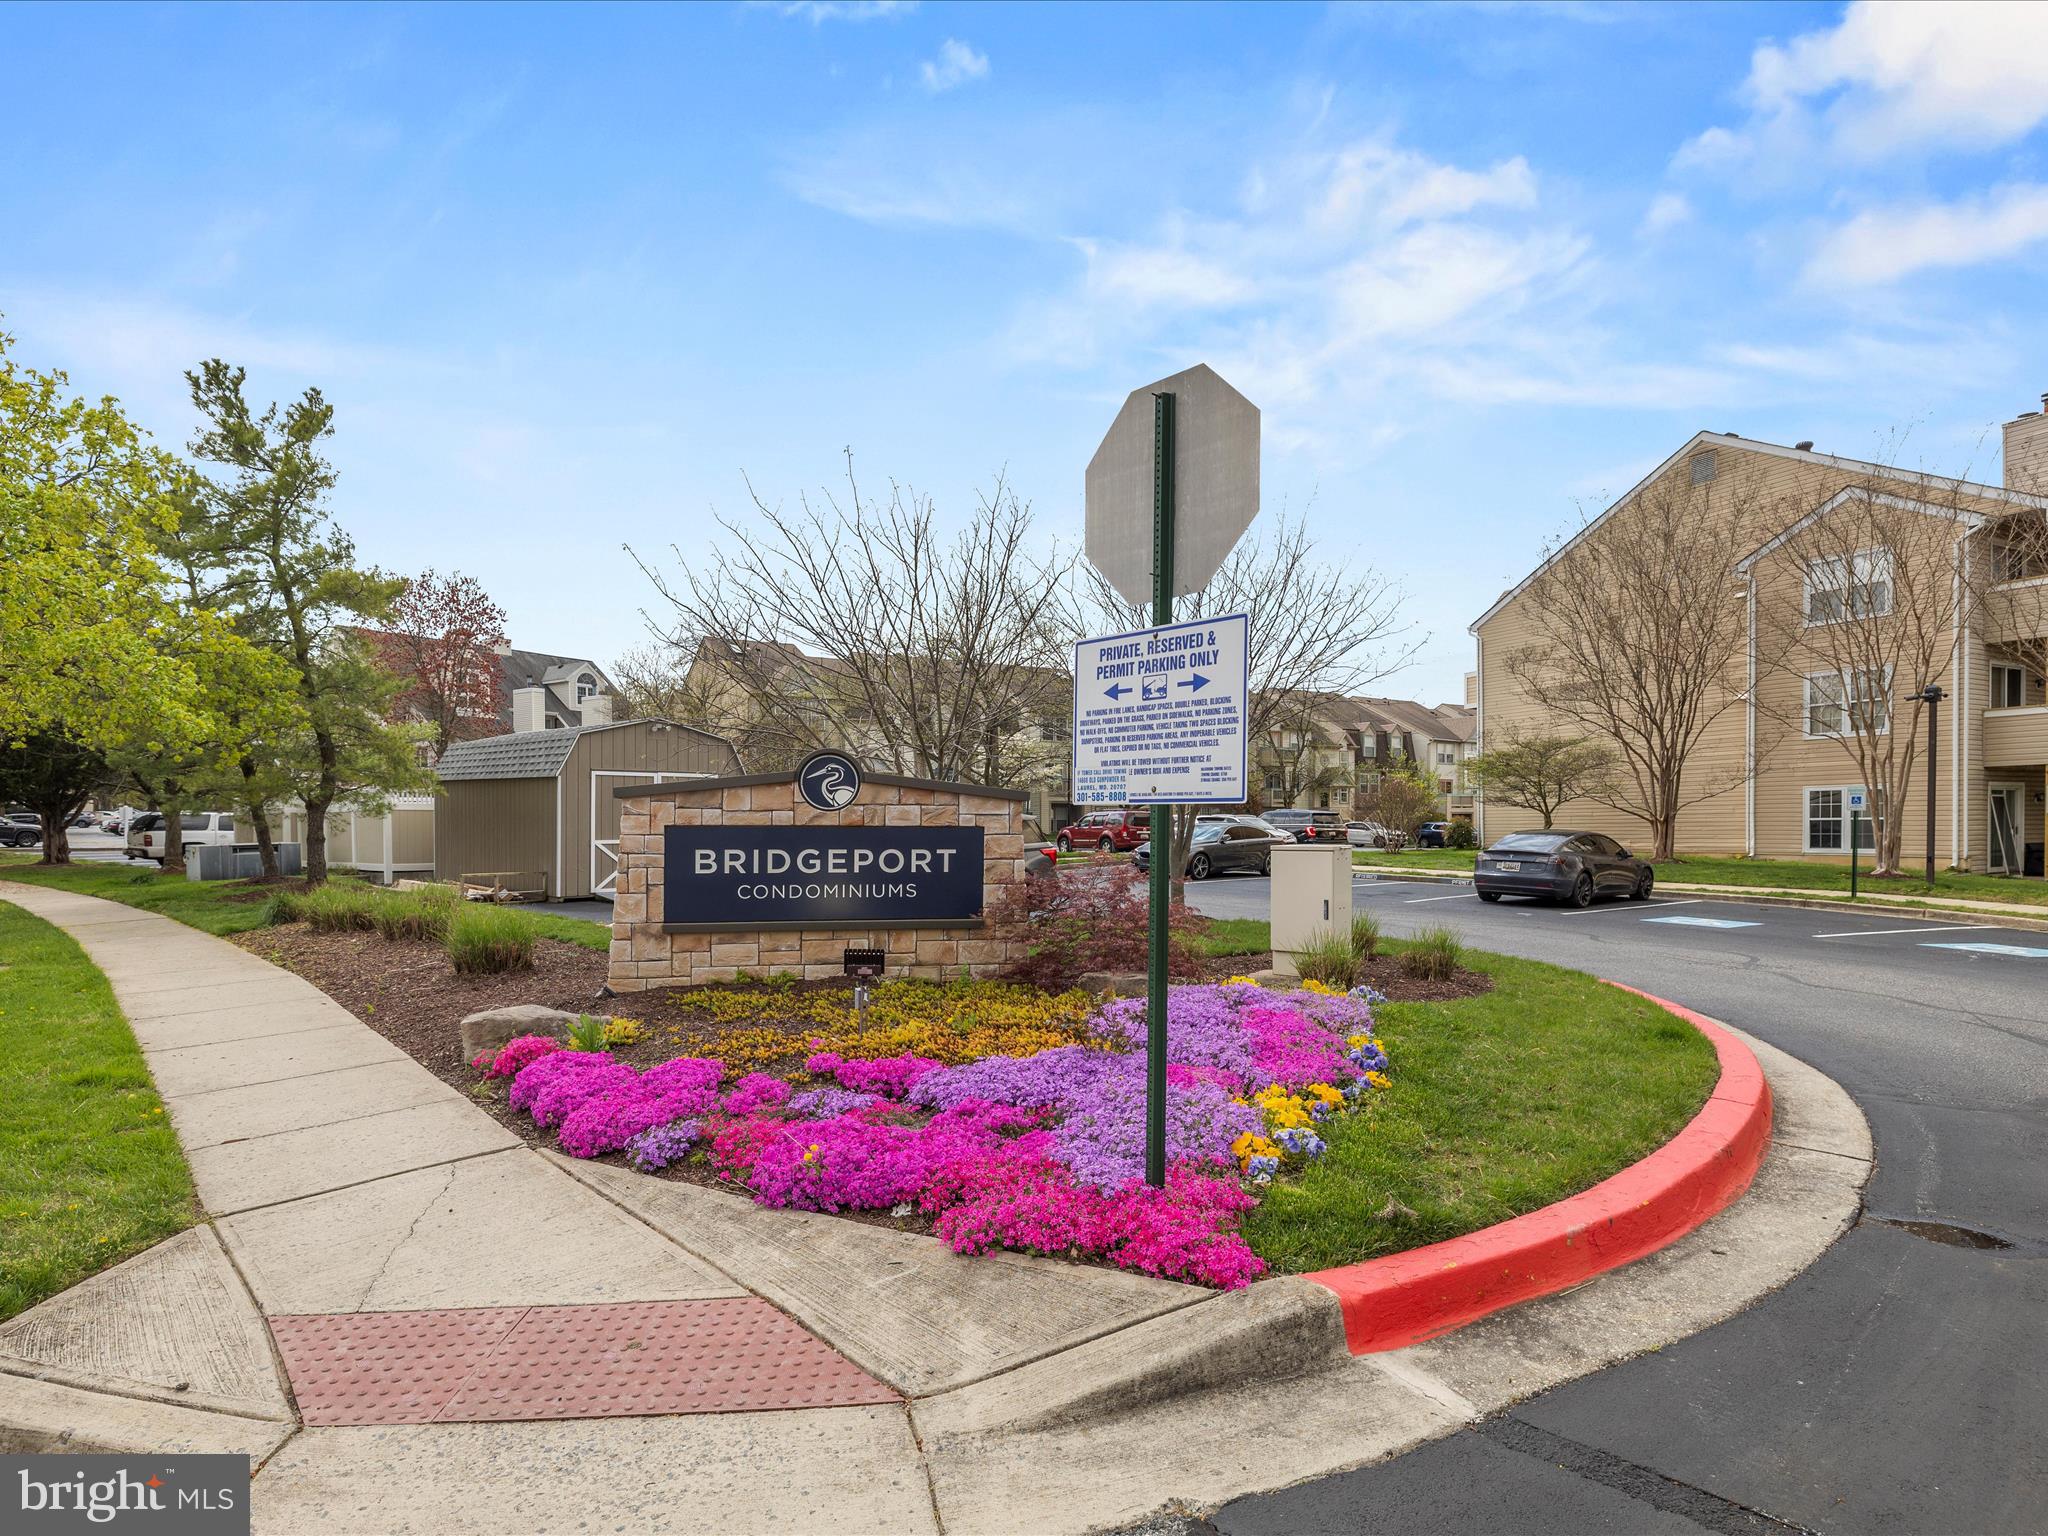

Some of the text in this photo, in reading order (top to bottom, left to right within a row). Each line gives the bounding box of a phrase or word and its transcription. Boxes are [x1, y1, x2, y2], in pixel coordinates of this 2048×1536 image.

[1100, 630, 1216, 662] PRIVATE, RESERVED &
[1097, 650, 1219, 680] PERMIT PARKING ONLY
[1092, 708, 1108, 716] PARKING
[1137, 704, 1156, 712] HANDICAP
[1210, 696, 1231, 705] BLOCKING
[1202, 708, 1221, 716] PARKING
[1115, 725, 1136, 733] COMMUTER
[1200, 718, 1216, 726] SPACES
[1217, 716, 1239, 725] BLOCKING
[1127, 734, 1145, 742] RESERVED
[1190, 729, 1215, 737] INOPERABLE
[1216, 727, 1237, 736] VEHICLES
[1170, 741, 1198, 749] COMMERCIAL
[1171, 756, 1189, 764] FURTHER
[1190, 755, 1205, 763] NOTICE
[1172, 766, 1190, 774] EXPENSE
[1077, 792, 1127, 801] 301-585-8808
[694, 848, 957, 874] BRIDGEPORT
[737, 884, 917, 899] CONDOMINIUMS
